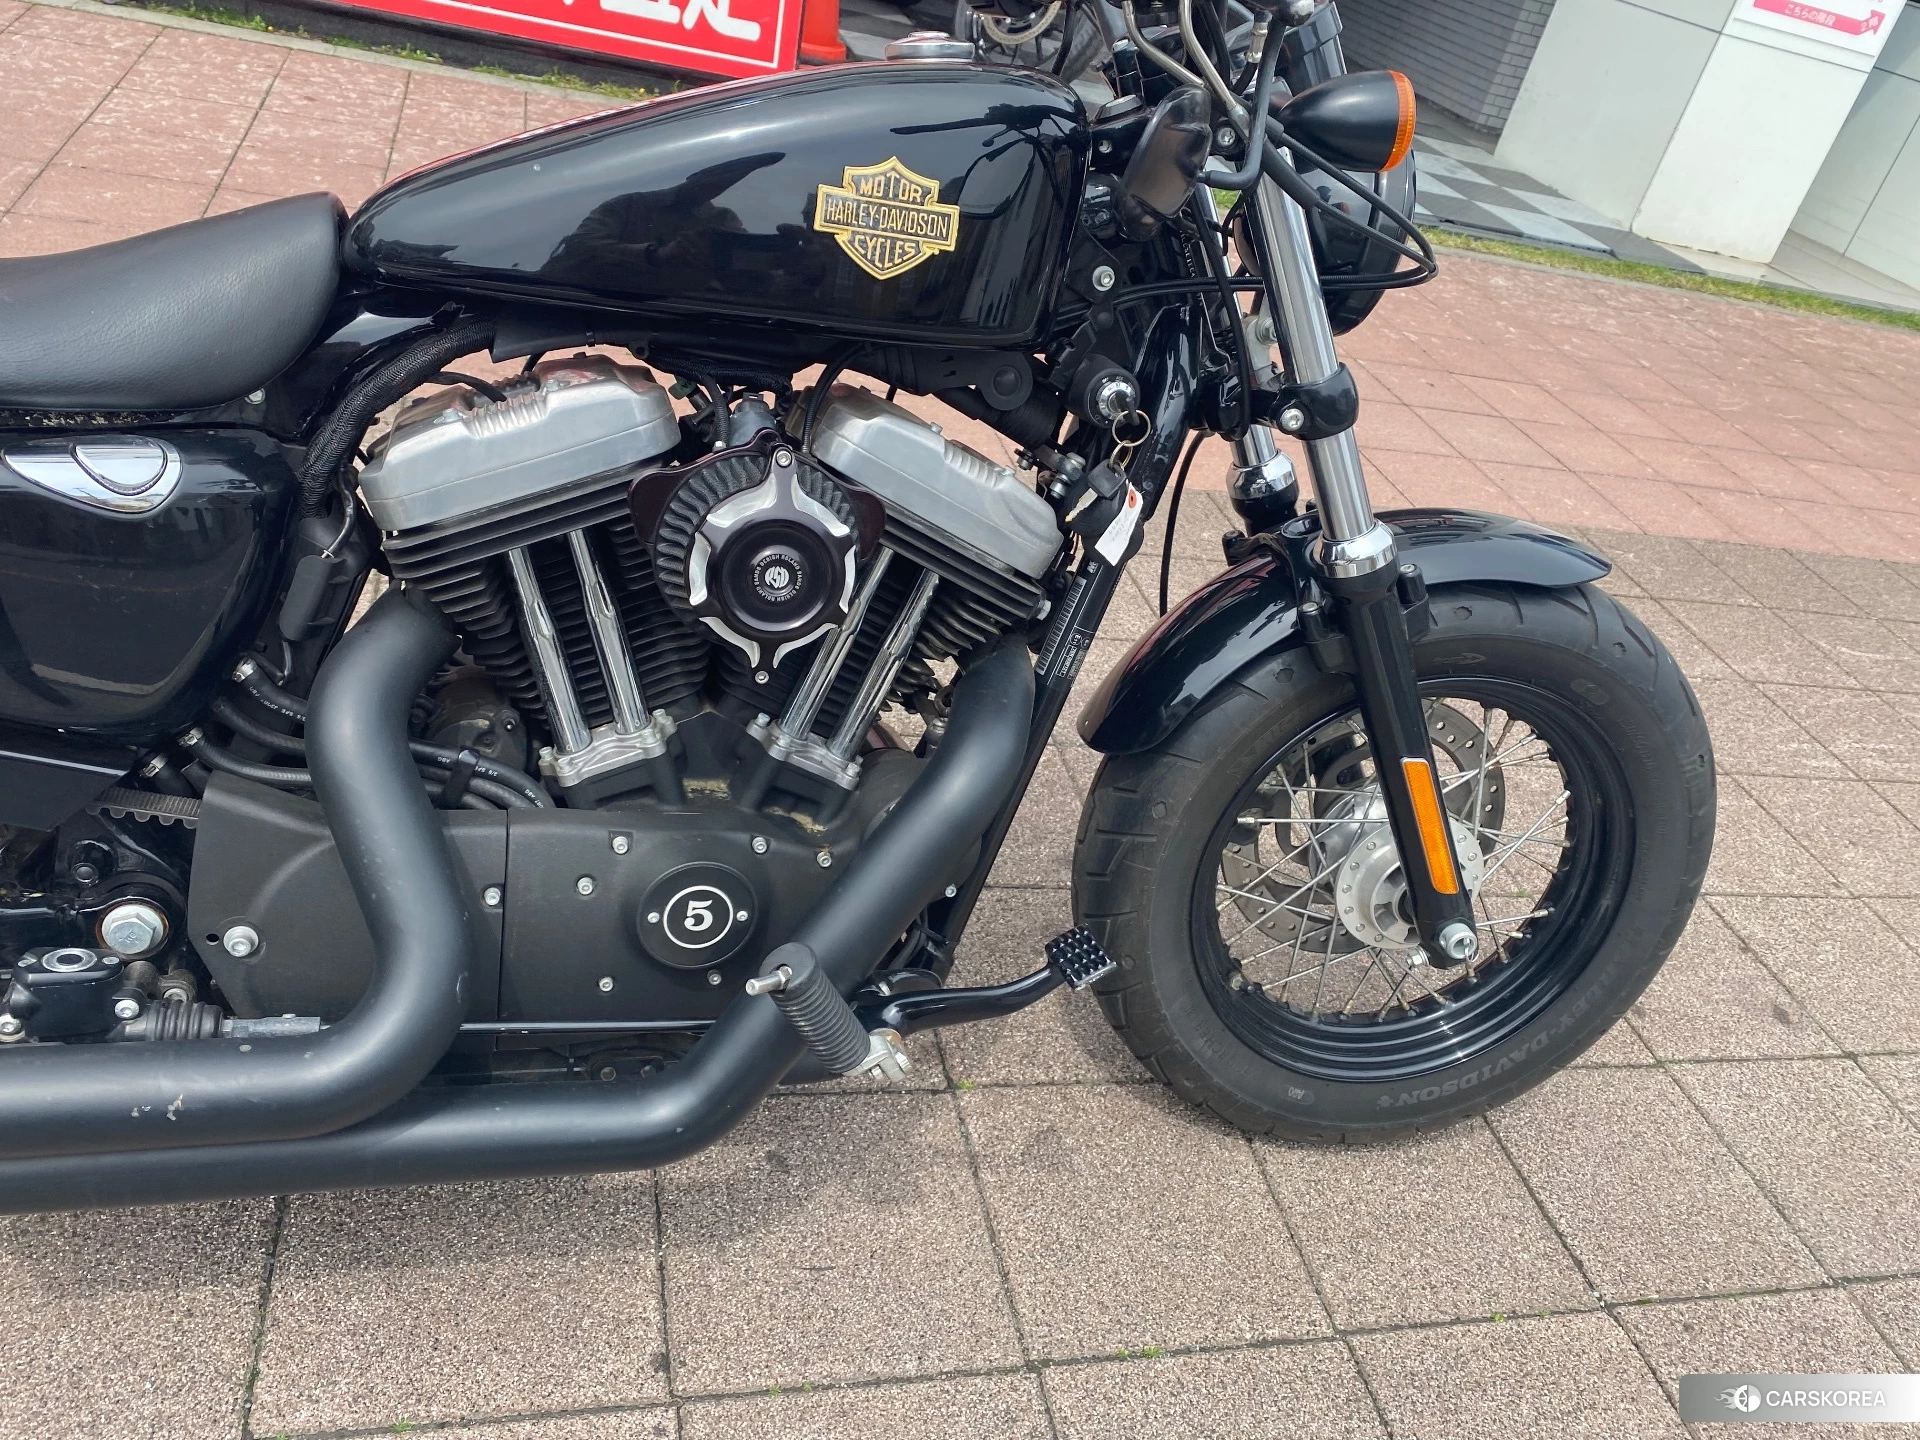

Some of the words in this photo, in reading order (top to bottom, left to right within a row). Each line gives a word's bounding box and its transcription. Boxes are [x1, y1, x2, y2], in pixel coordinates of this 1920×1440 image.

[859, 170, 923, 203] MOTOR
[854, 234, 916, 269] CYCLES
[683, 899, 713, 932] 5
